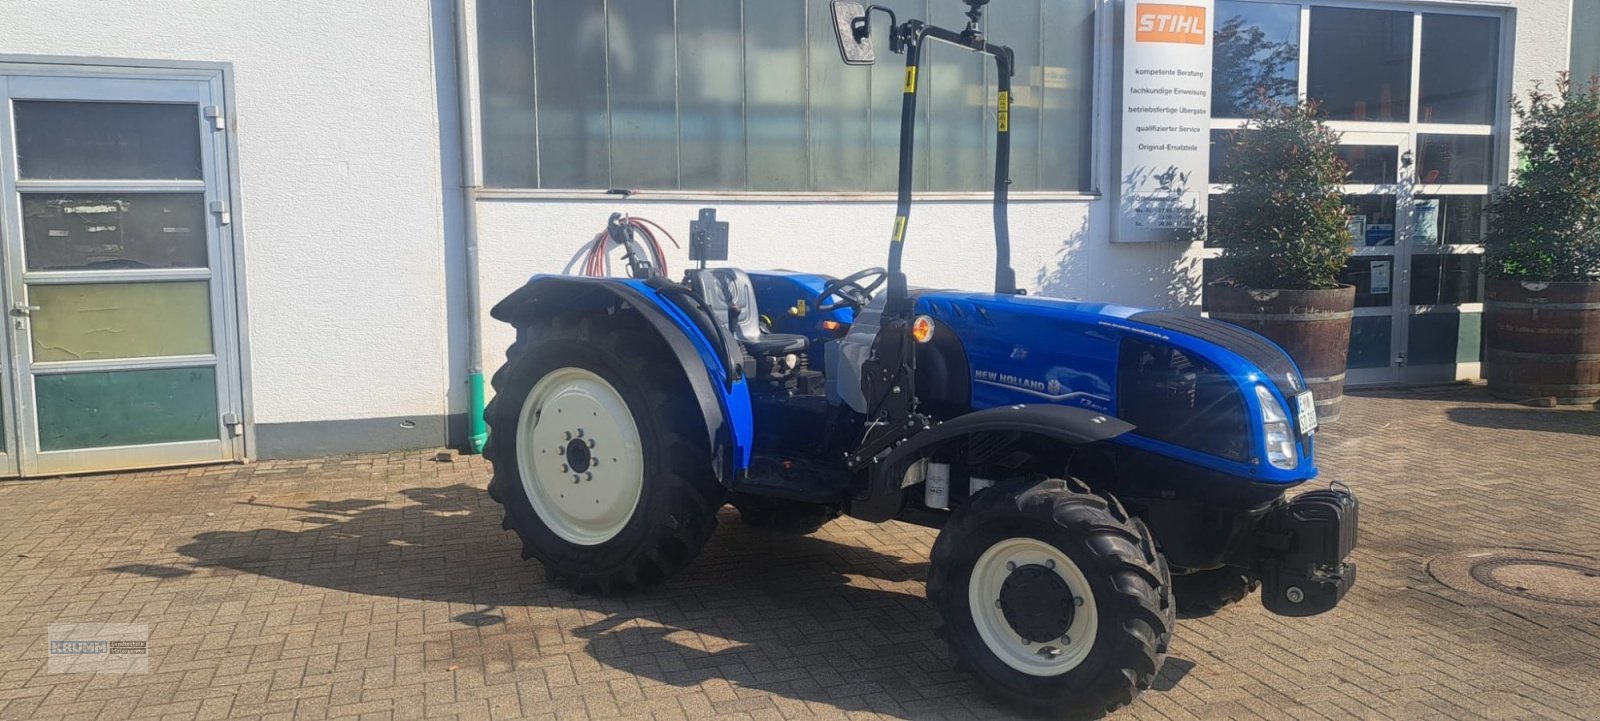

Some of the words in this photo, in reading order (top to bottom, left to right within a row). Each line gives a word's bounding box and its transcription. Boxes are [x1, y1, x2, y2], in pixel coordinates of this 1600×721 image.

[1138, 14, 1204, 35] STIHL
[1136, 67, 1175, 77] kompetente
[1177, 69, 1204, 78] Beratung
[1130, 87, 1172, 95] fachkundige
[1174, 88, 1207, 97] Einweisung
[1128, 106, 1178, 115] betriebsfertige
[1179, 106, 1207, 115] Übergabe
[1136, 125, 1177, 133] qualifizierter
[1179, 125, 1200, 133] Service
[1138, 143, 1198, 152] Original-Ersatzteile
[974, 370, 997, 381] NEW
[999, 373, 1046, 391] HOLLAND
